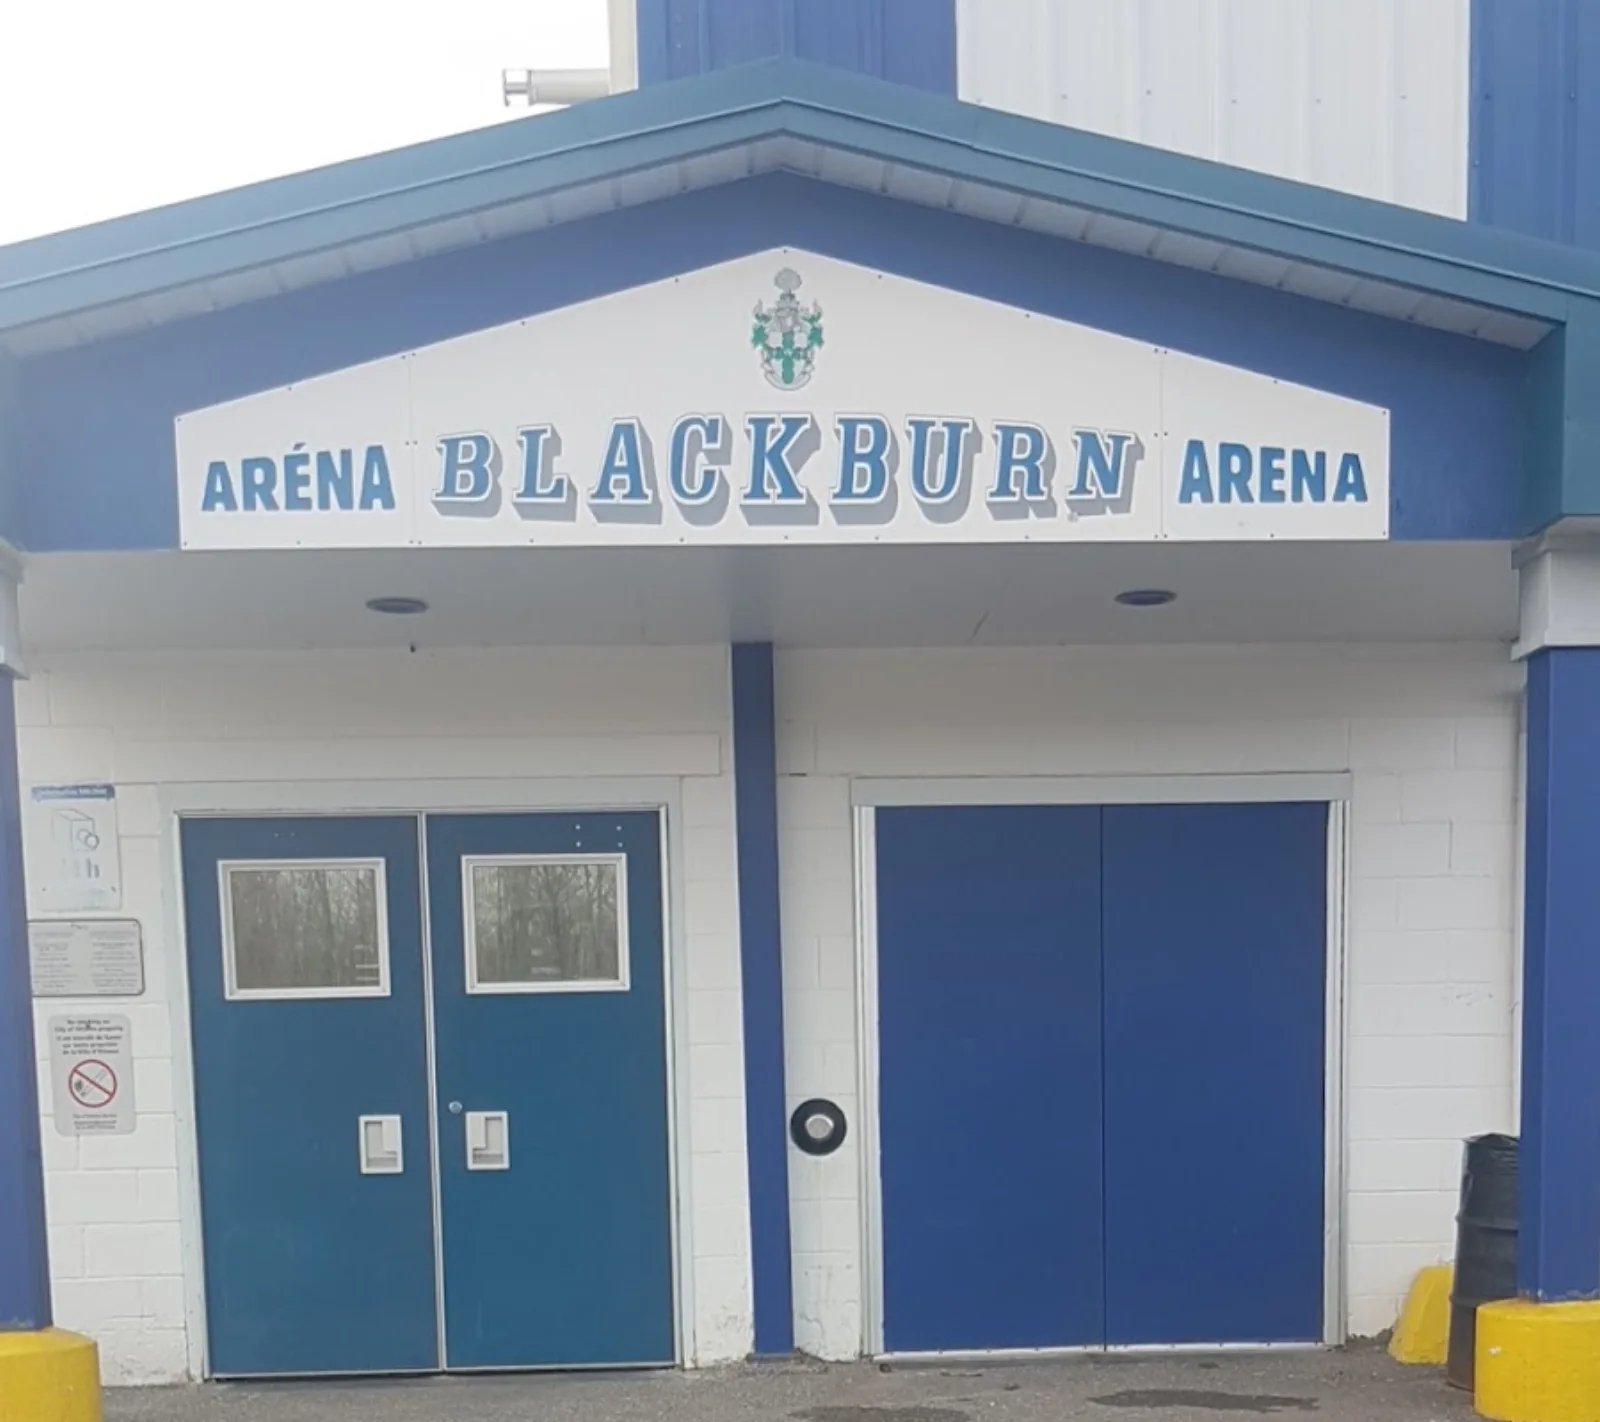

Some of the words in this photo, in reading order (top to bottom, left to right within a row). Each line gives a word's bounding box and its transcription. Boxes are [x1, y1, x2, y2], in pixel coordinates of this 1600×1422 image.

[202, 442, 396, 512] ARÉNA
[431, 412, 1146, 527] BLACKBURN
[1179, 438, 1368, 504] ARENA
